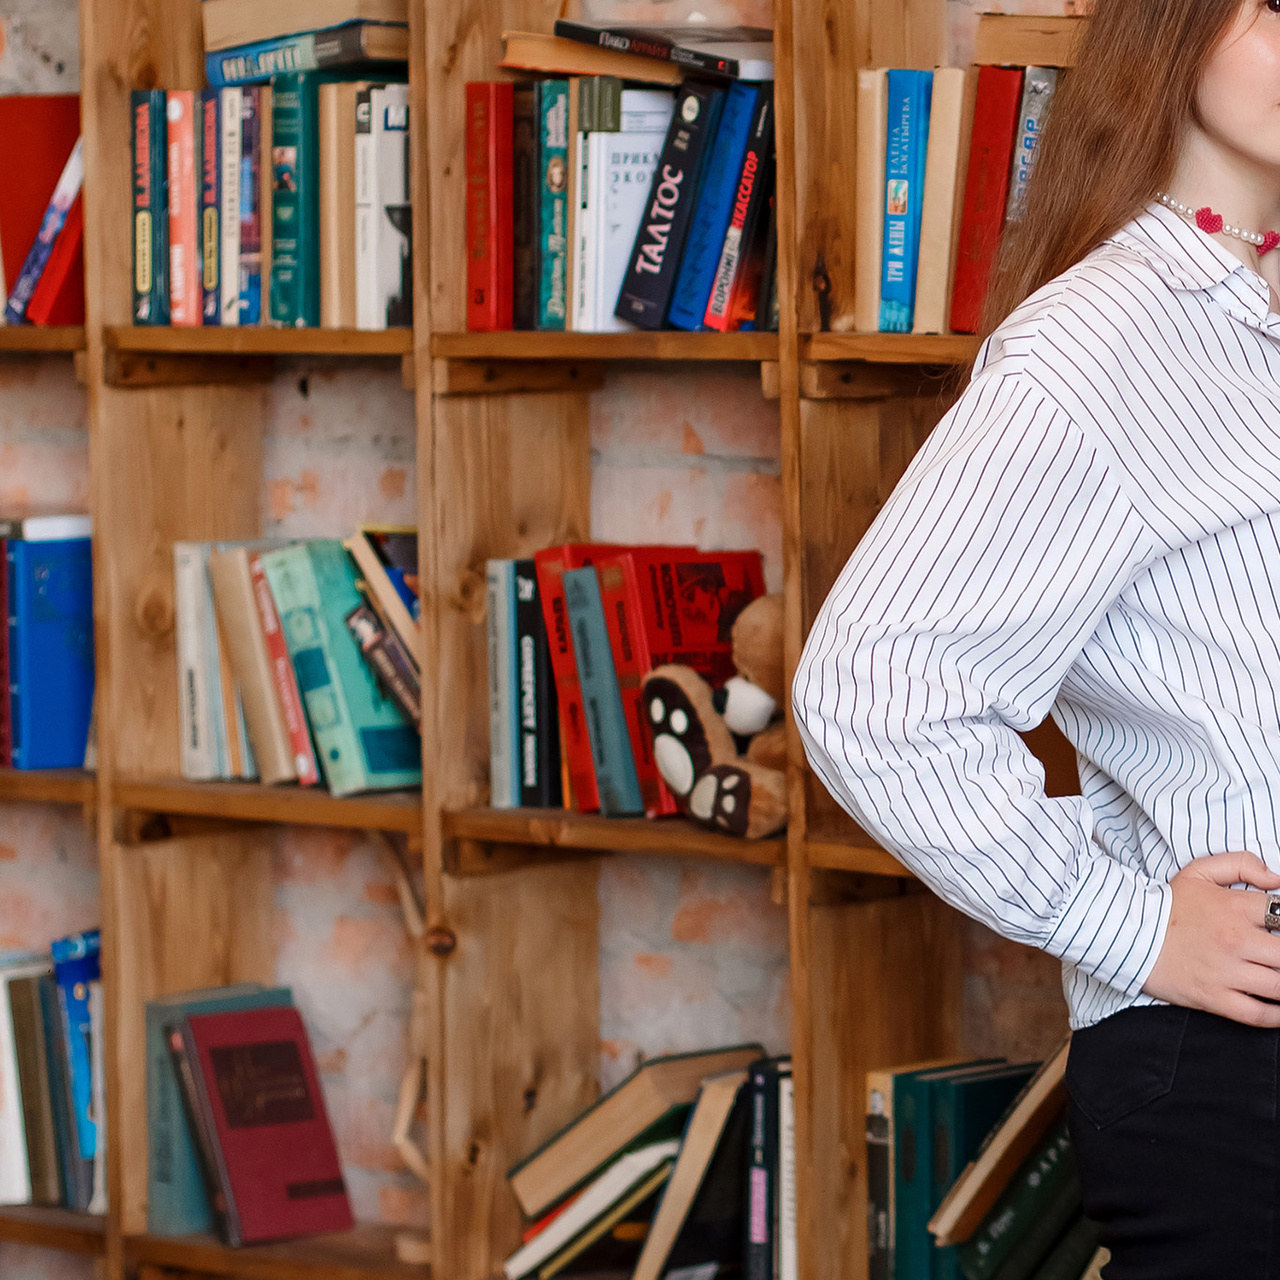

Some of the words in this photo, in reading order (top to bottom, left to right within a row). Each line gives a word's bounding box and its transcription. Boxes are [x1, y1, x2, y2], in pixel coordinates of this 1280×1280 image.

[636, 164, 684, 275] ТАЛТОС
[731, 150, 760, 231] НКАССАТОР
[889, 221, 904, 256] ЖЕНЫ
[887, 261, 903, 282] ТРИ
